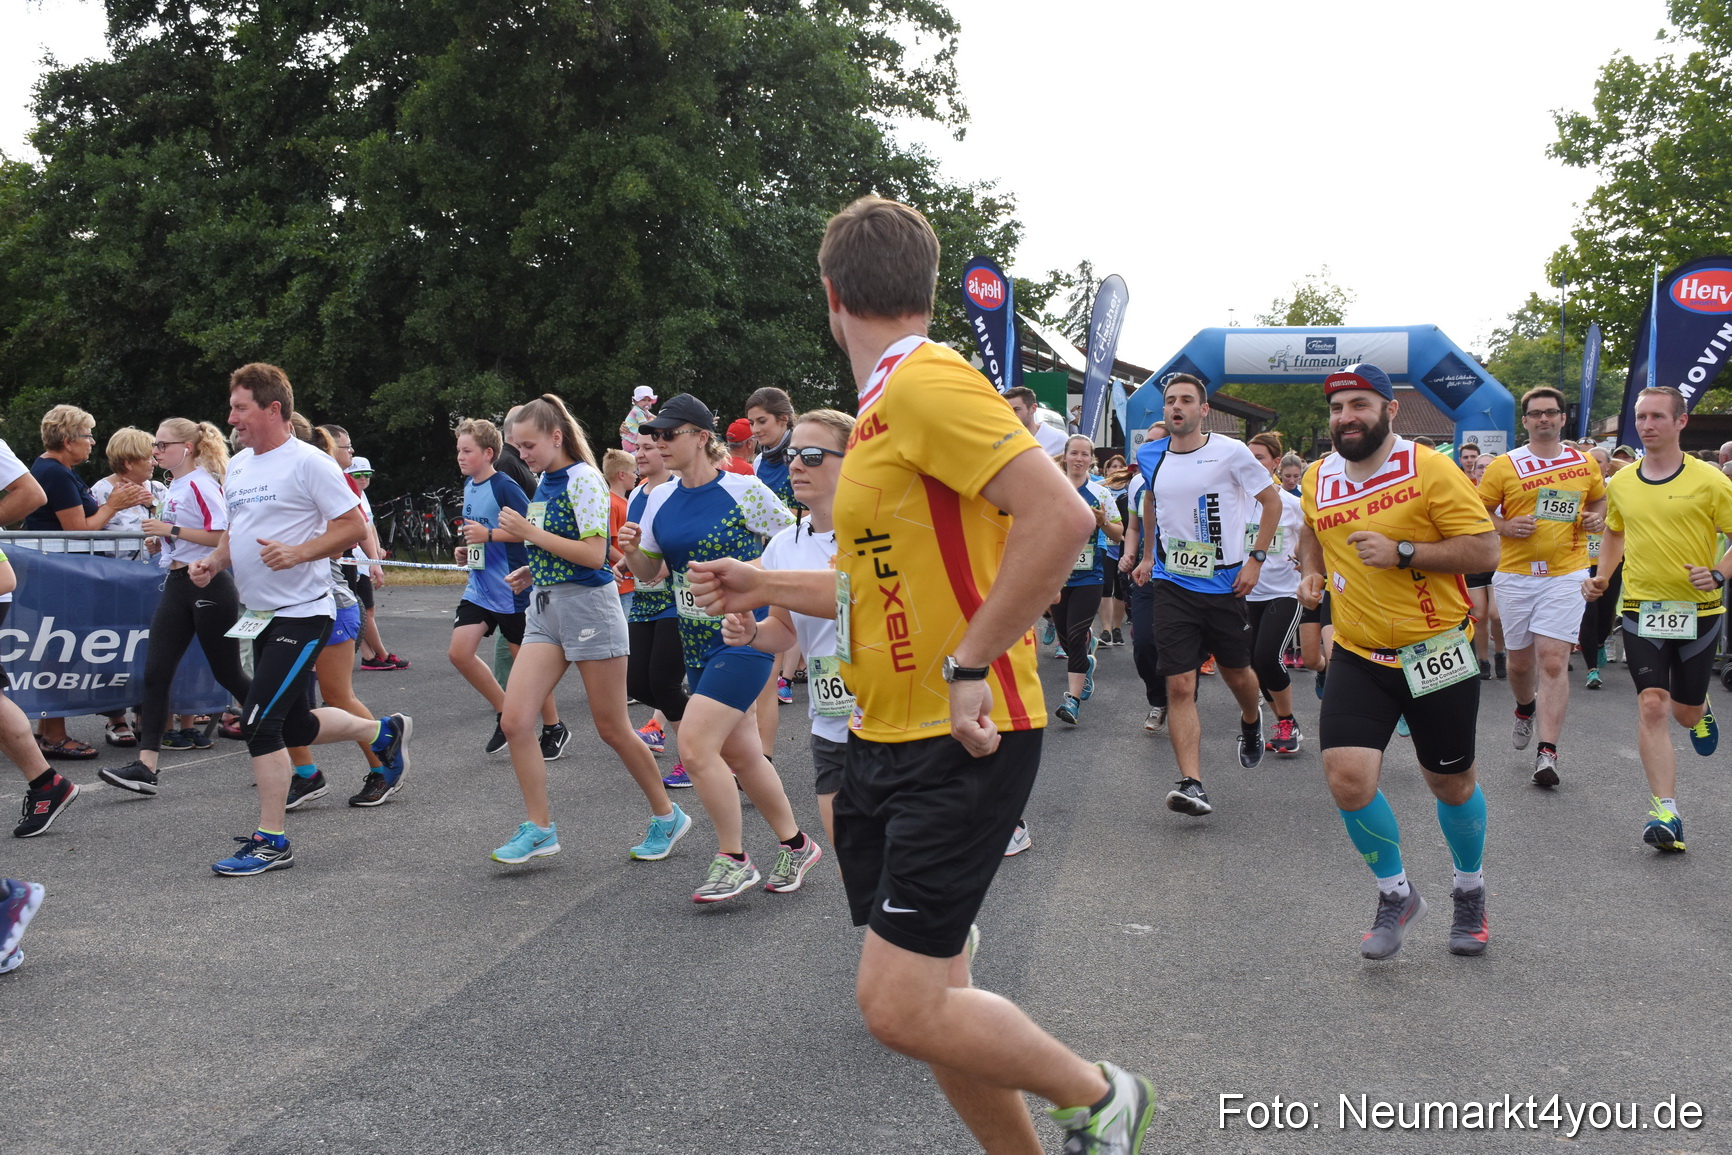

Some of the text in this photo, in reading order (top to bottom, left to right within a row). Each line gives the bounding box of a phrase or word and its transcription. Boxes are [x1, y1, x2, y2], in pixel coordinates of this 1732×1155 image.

[1307, 340, 1335, 350] Fischer
[1293, 354, 1363, 367] firmenlauf
[1521, 467, 1591, 491] MAX BÖGL
[239, 486, 257, 496] Sport
[1317, 486, 1421, 532] MAX BÖGL
[1542, 500, 1574, 513] 1585
[1172, 551, 1208, 568] 1042
[1646, 614, 1689, 628] 2187
[0, 617, 149, 663] cher
[1414, 647, 1464, 679] 1661
[1421, 665, 1467, 685] Rosca Constantin
